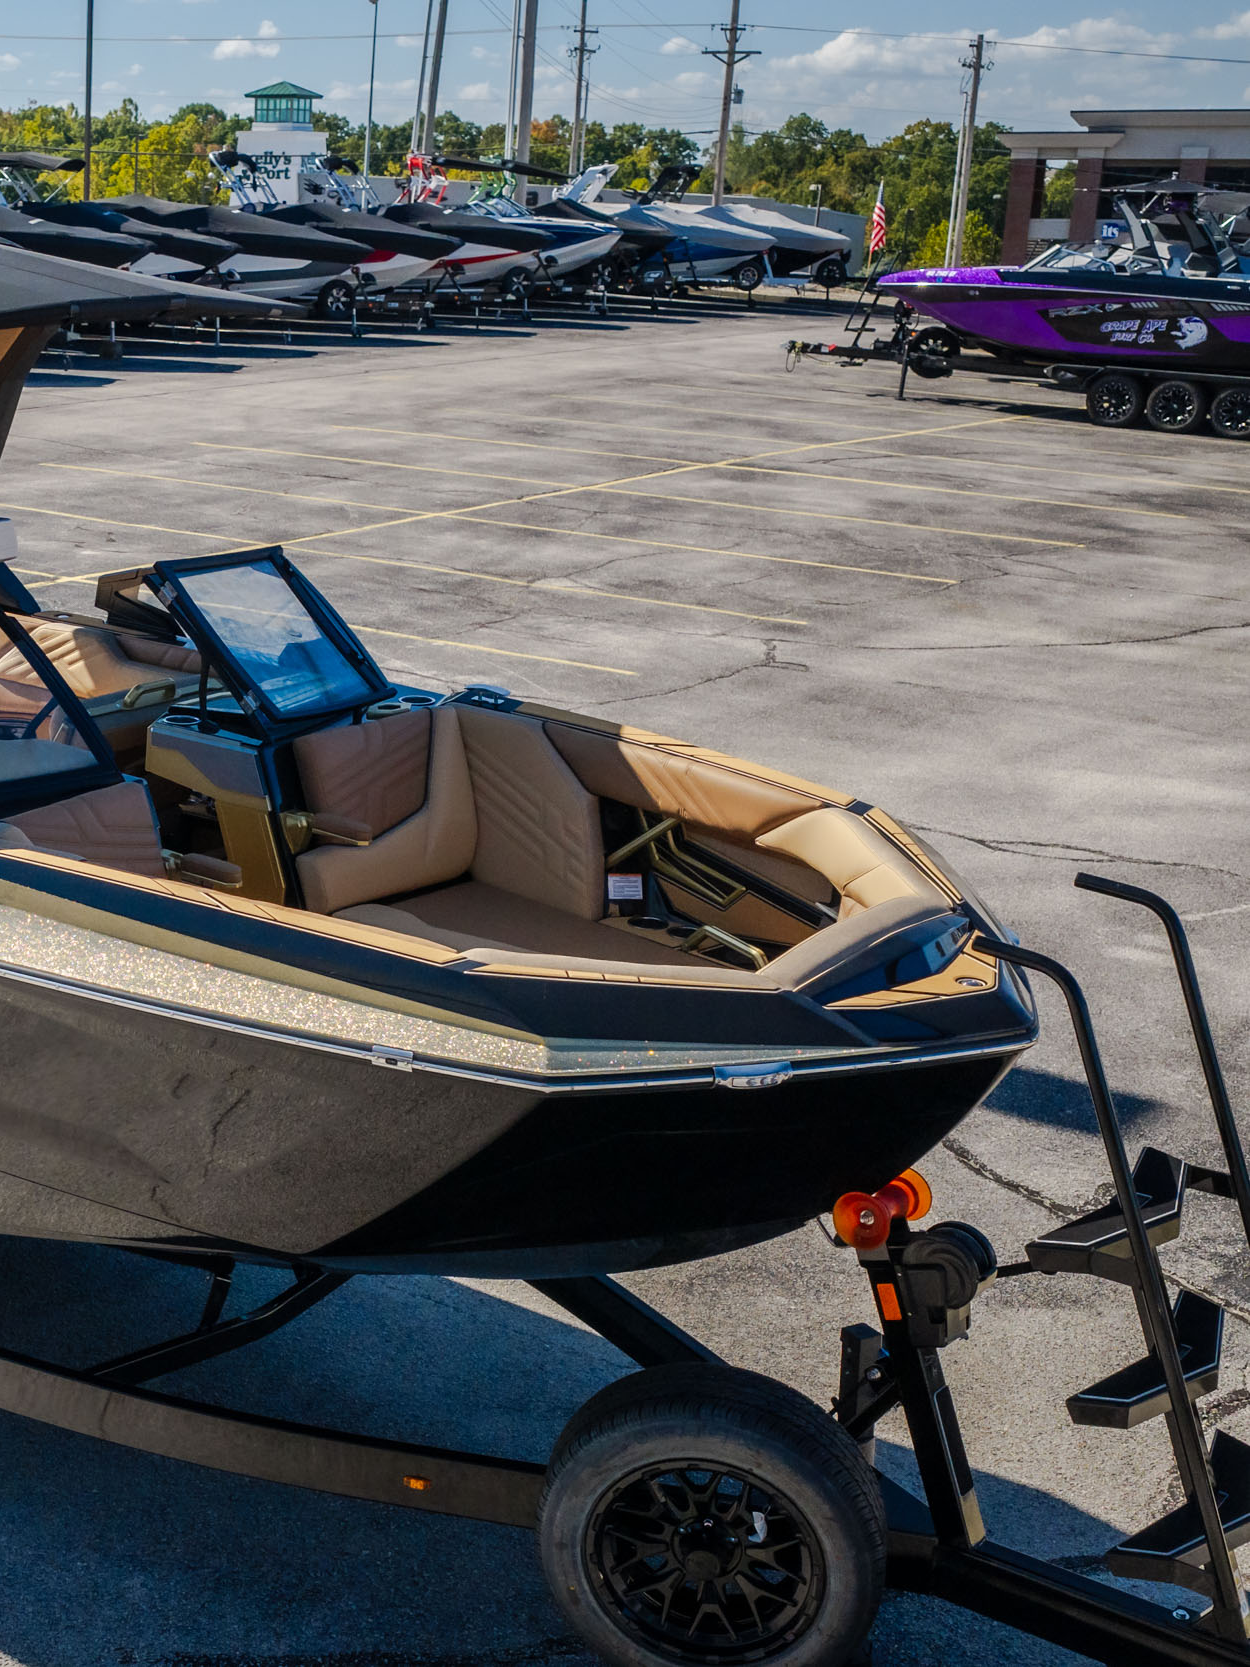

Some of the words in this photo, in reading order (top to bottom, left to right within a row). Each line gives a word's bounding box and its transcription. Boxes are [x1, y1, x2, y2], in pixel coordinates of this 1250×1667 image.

[253, 151, 291, 168] elly's
[1100, 319, 1141, 333] GRAPE
[1141, 319, 1169, 333] APE
